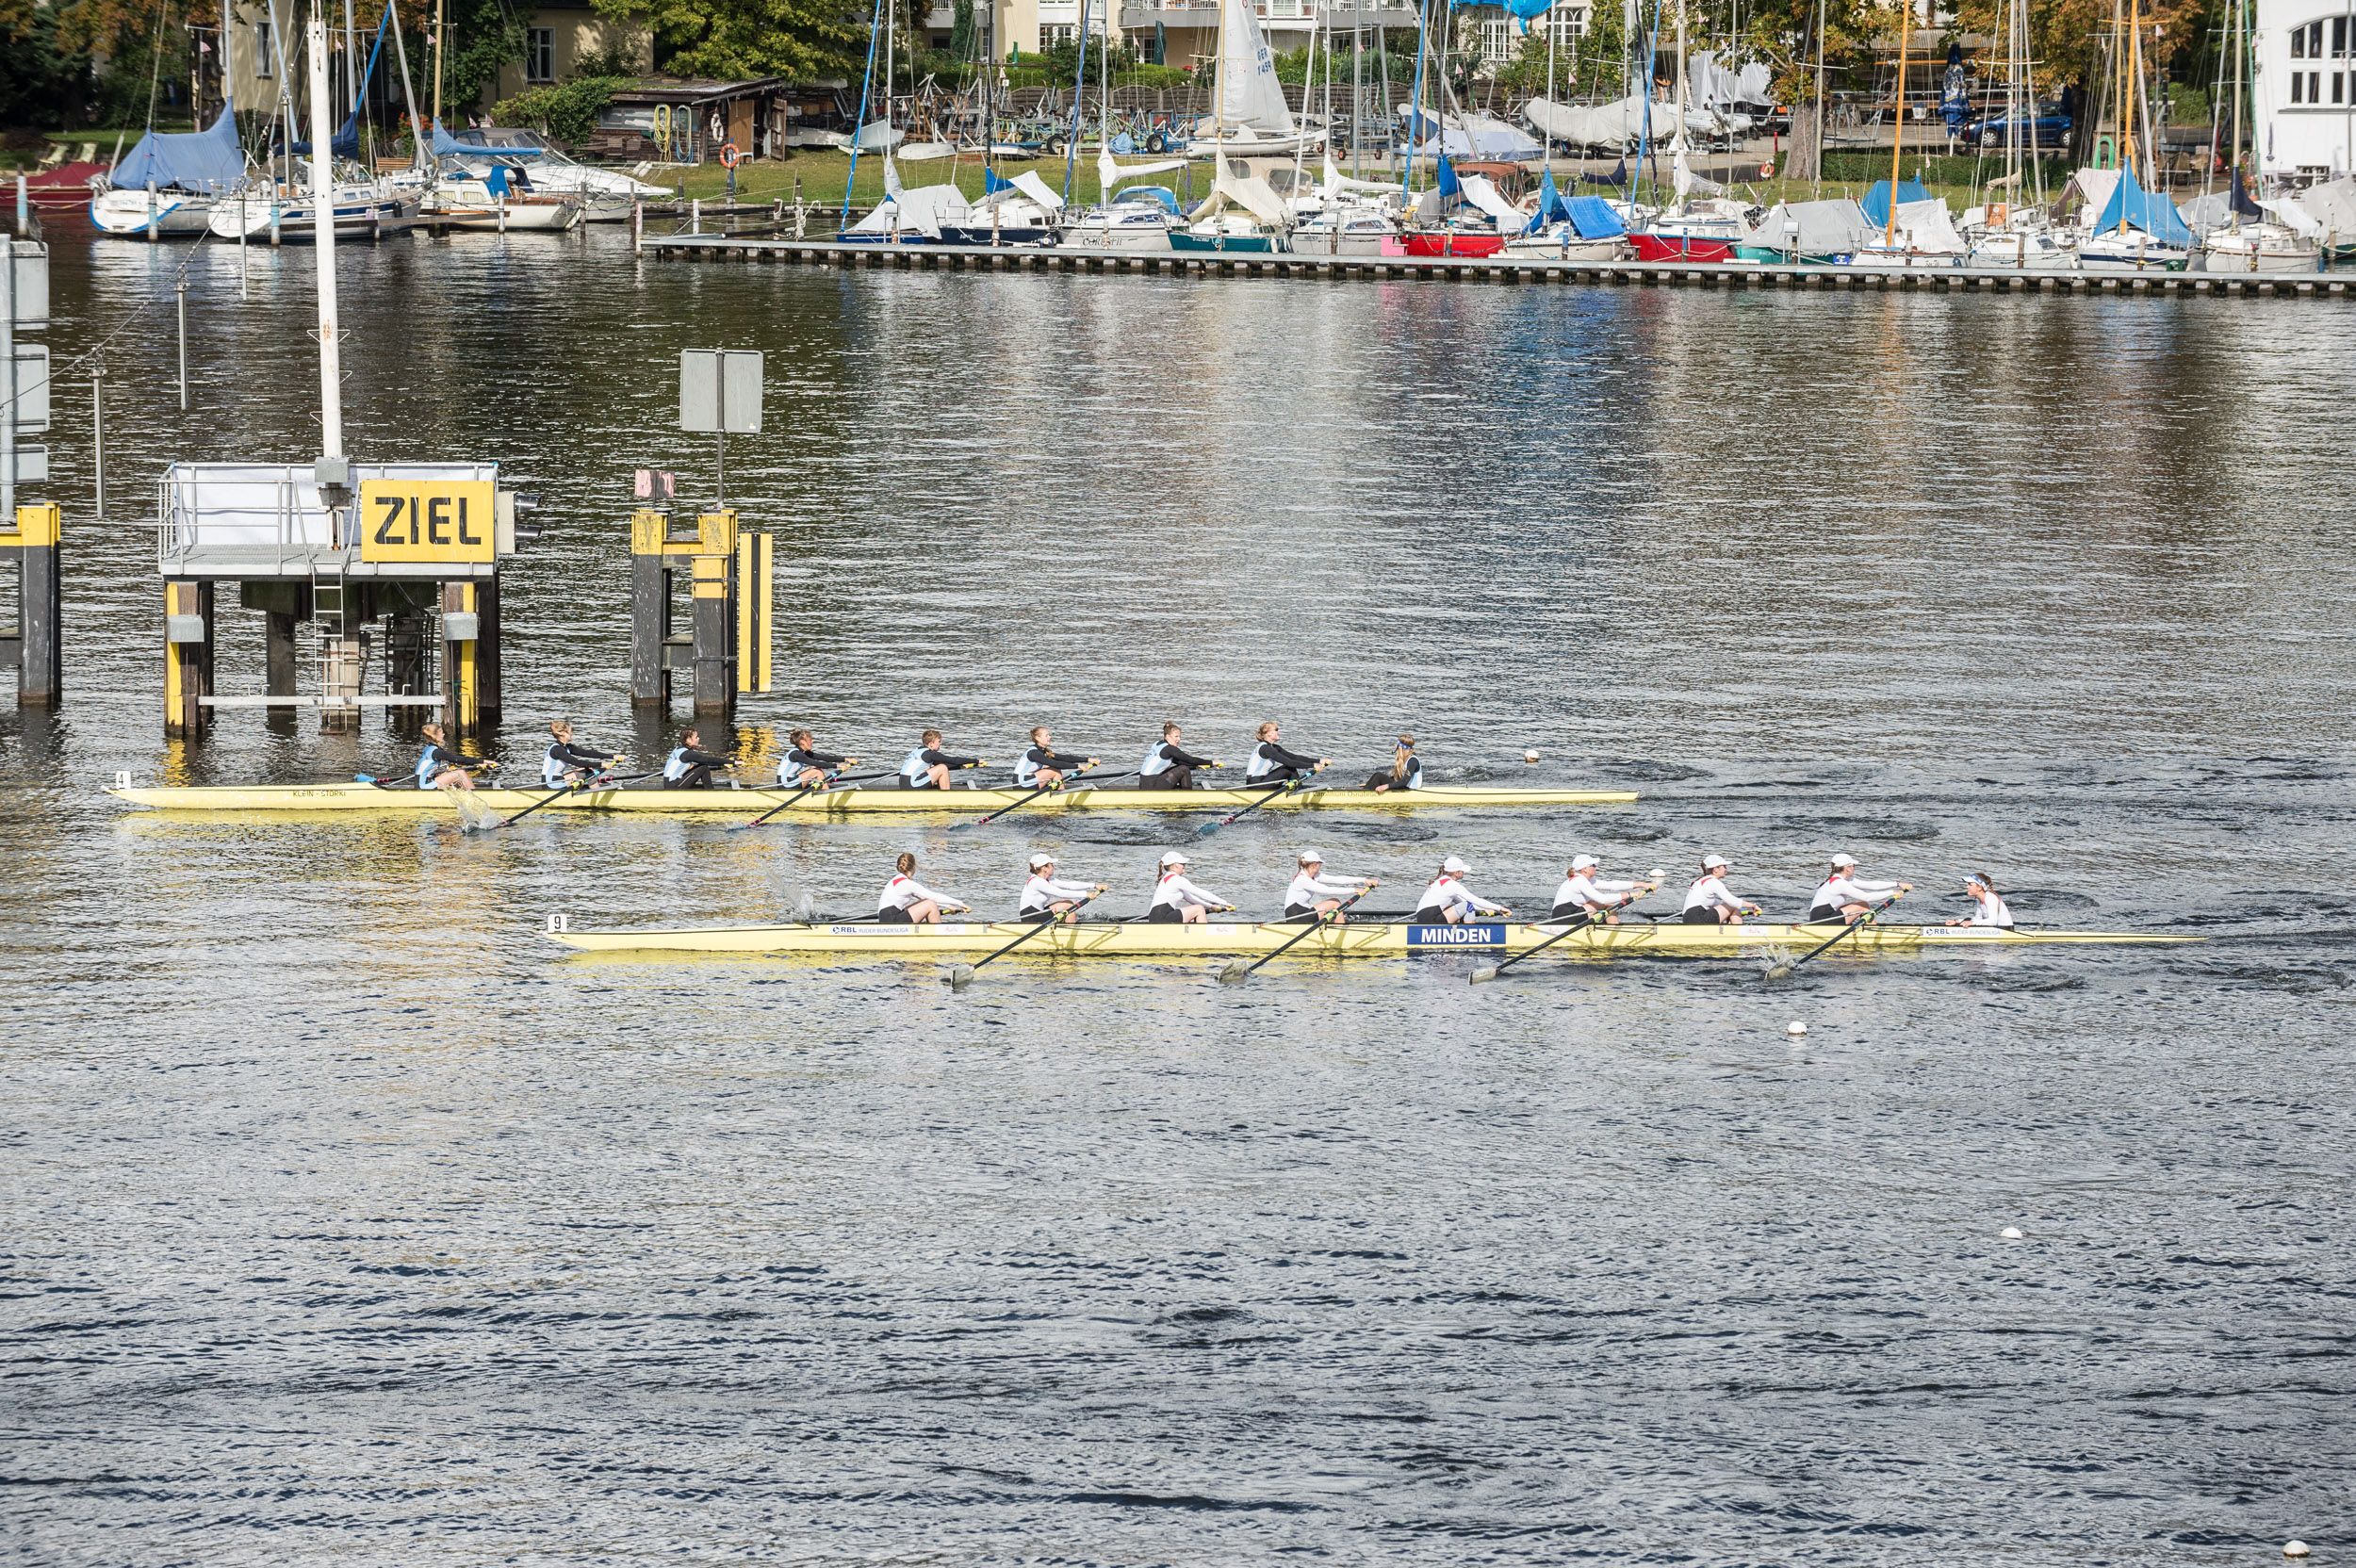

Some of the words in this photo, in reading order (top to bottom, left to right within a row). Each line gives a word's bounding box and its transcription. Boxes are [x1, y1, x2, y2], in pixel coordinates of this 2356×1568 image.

[374, 497, 482, 545] ZIEL
[118, 773, 124, 785] 4
[554, 915, 562, 930] 9
[1421, 928, 1491, 943] MINDEN
